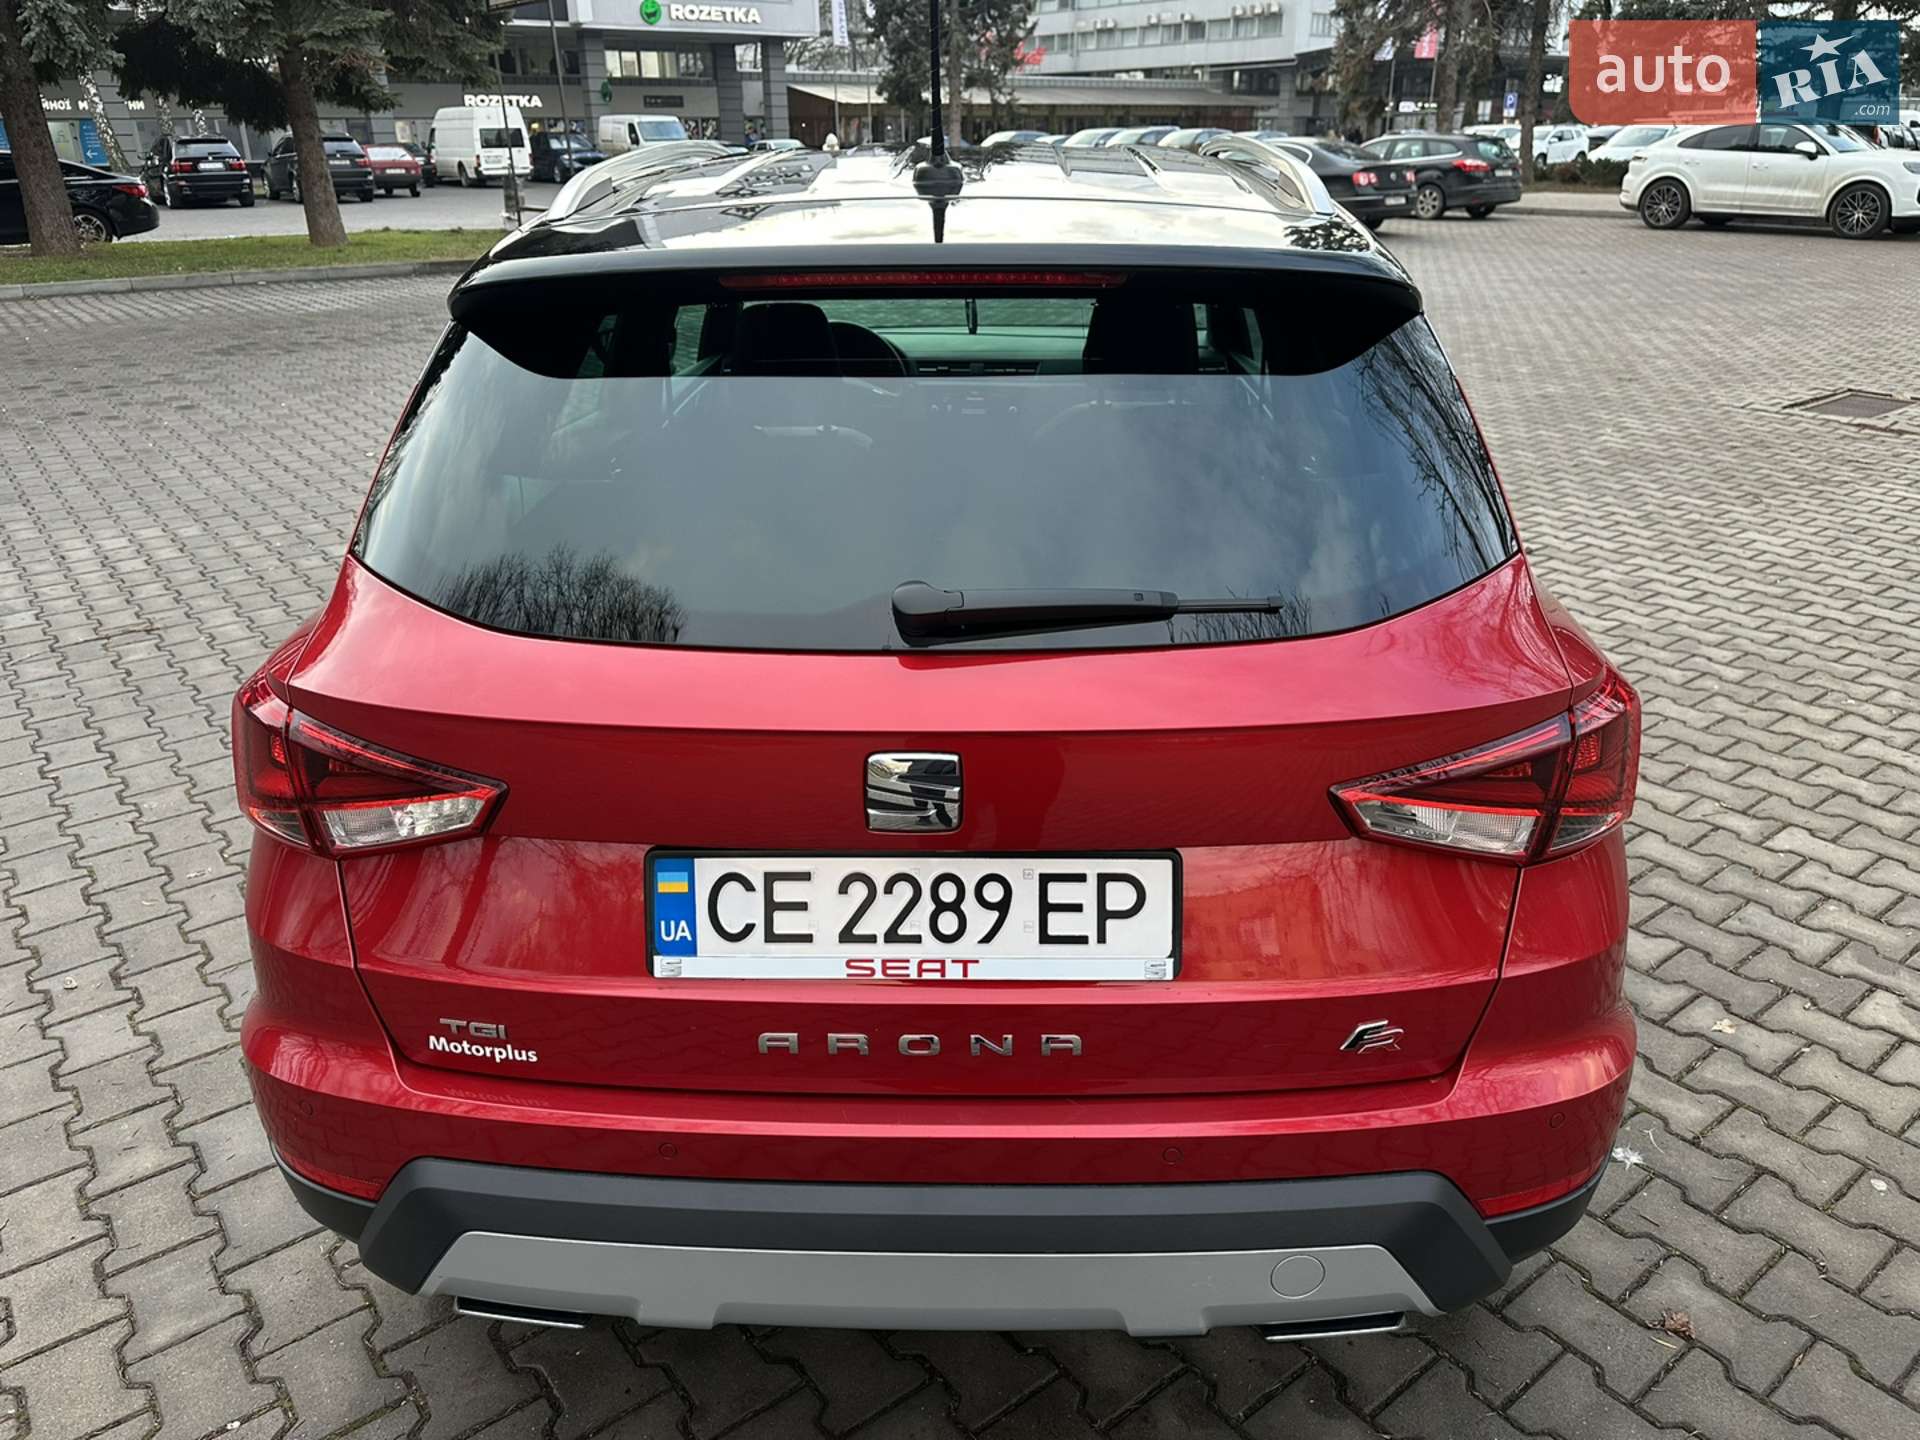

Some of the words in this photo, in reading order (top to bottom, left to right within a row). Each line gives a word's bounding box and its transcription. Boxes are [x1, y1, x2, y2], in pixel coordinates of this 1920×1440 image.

[669, 4, 761, 23] ROZETKA
[463, 94, 543, 107] ROZETKA
[707, 871, 814, 943] CE
[837, 872, 1013, 944] 2289
[1037, 872, 1147, 944] EP
[660, 920, 692, 941] UA
[845, 959, 980, 978] SEAT
[439, 1017, 506, 1040] TGI
[428, 1035, 538, 1063] Motorplus
[758, 1032, 1083, 1056] ARONA
